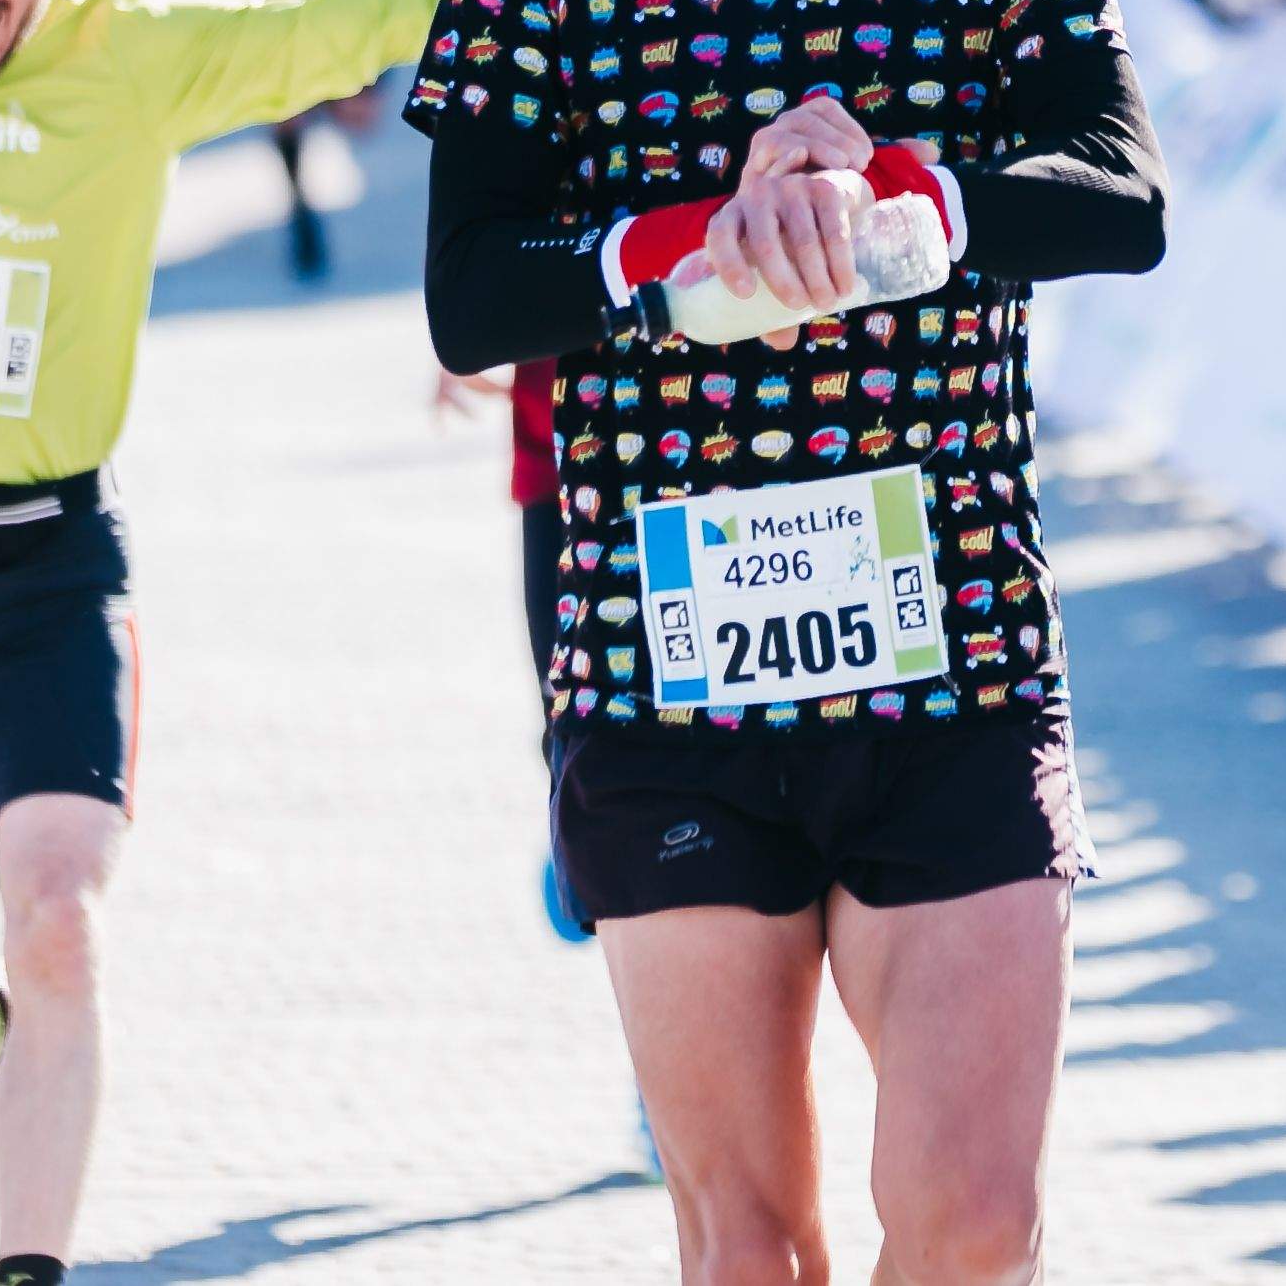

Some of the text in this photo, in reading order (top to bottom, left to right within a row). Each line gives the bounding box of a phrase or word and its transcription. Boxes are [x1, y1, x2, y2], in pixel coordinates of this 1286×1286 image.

[690, 36, 728, 54] OOPS!
[804, 27, 842, 53] COOL!
[854, 26, 892, 46] OOPS!
[913, 36, 945, 50] WOW!
[642, 38, 678, 64] COOL!
[749, 41, 782, 55] WOW!
[1016, 34, 1042, 60] HEY
[745, 90, 786, 111] SMILE!
[907, 83, 945, 100] SMILE!
[698, 147, 728, 168] HEY
[865, 314, 894, 336] HEY
[919, 312, 944, 333] OK
[660, 374, 692, 401] COOL!
[701, 377, 736, 396] OOPS!
[812, 371, 850, 397] COOL!
[861, 371, 897, 390] OOPS!
[755, 385, 791, 399] WOW!
[751, 505, 863, 541] MetLife
[960, 525, 994, 551] COOL!
[724, 550, 813, 589] 4296
[716, 603, 878, 684] 2405
[820, 694, 857, 719] COOL!
